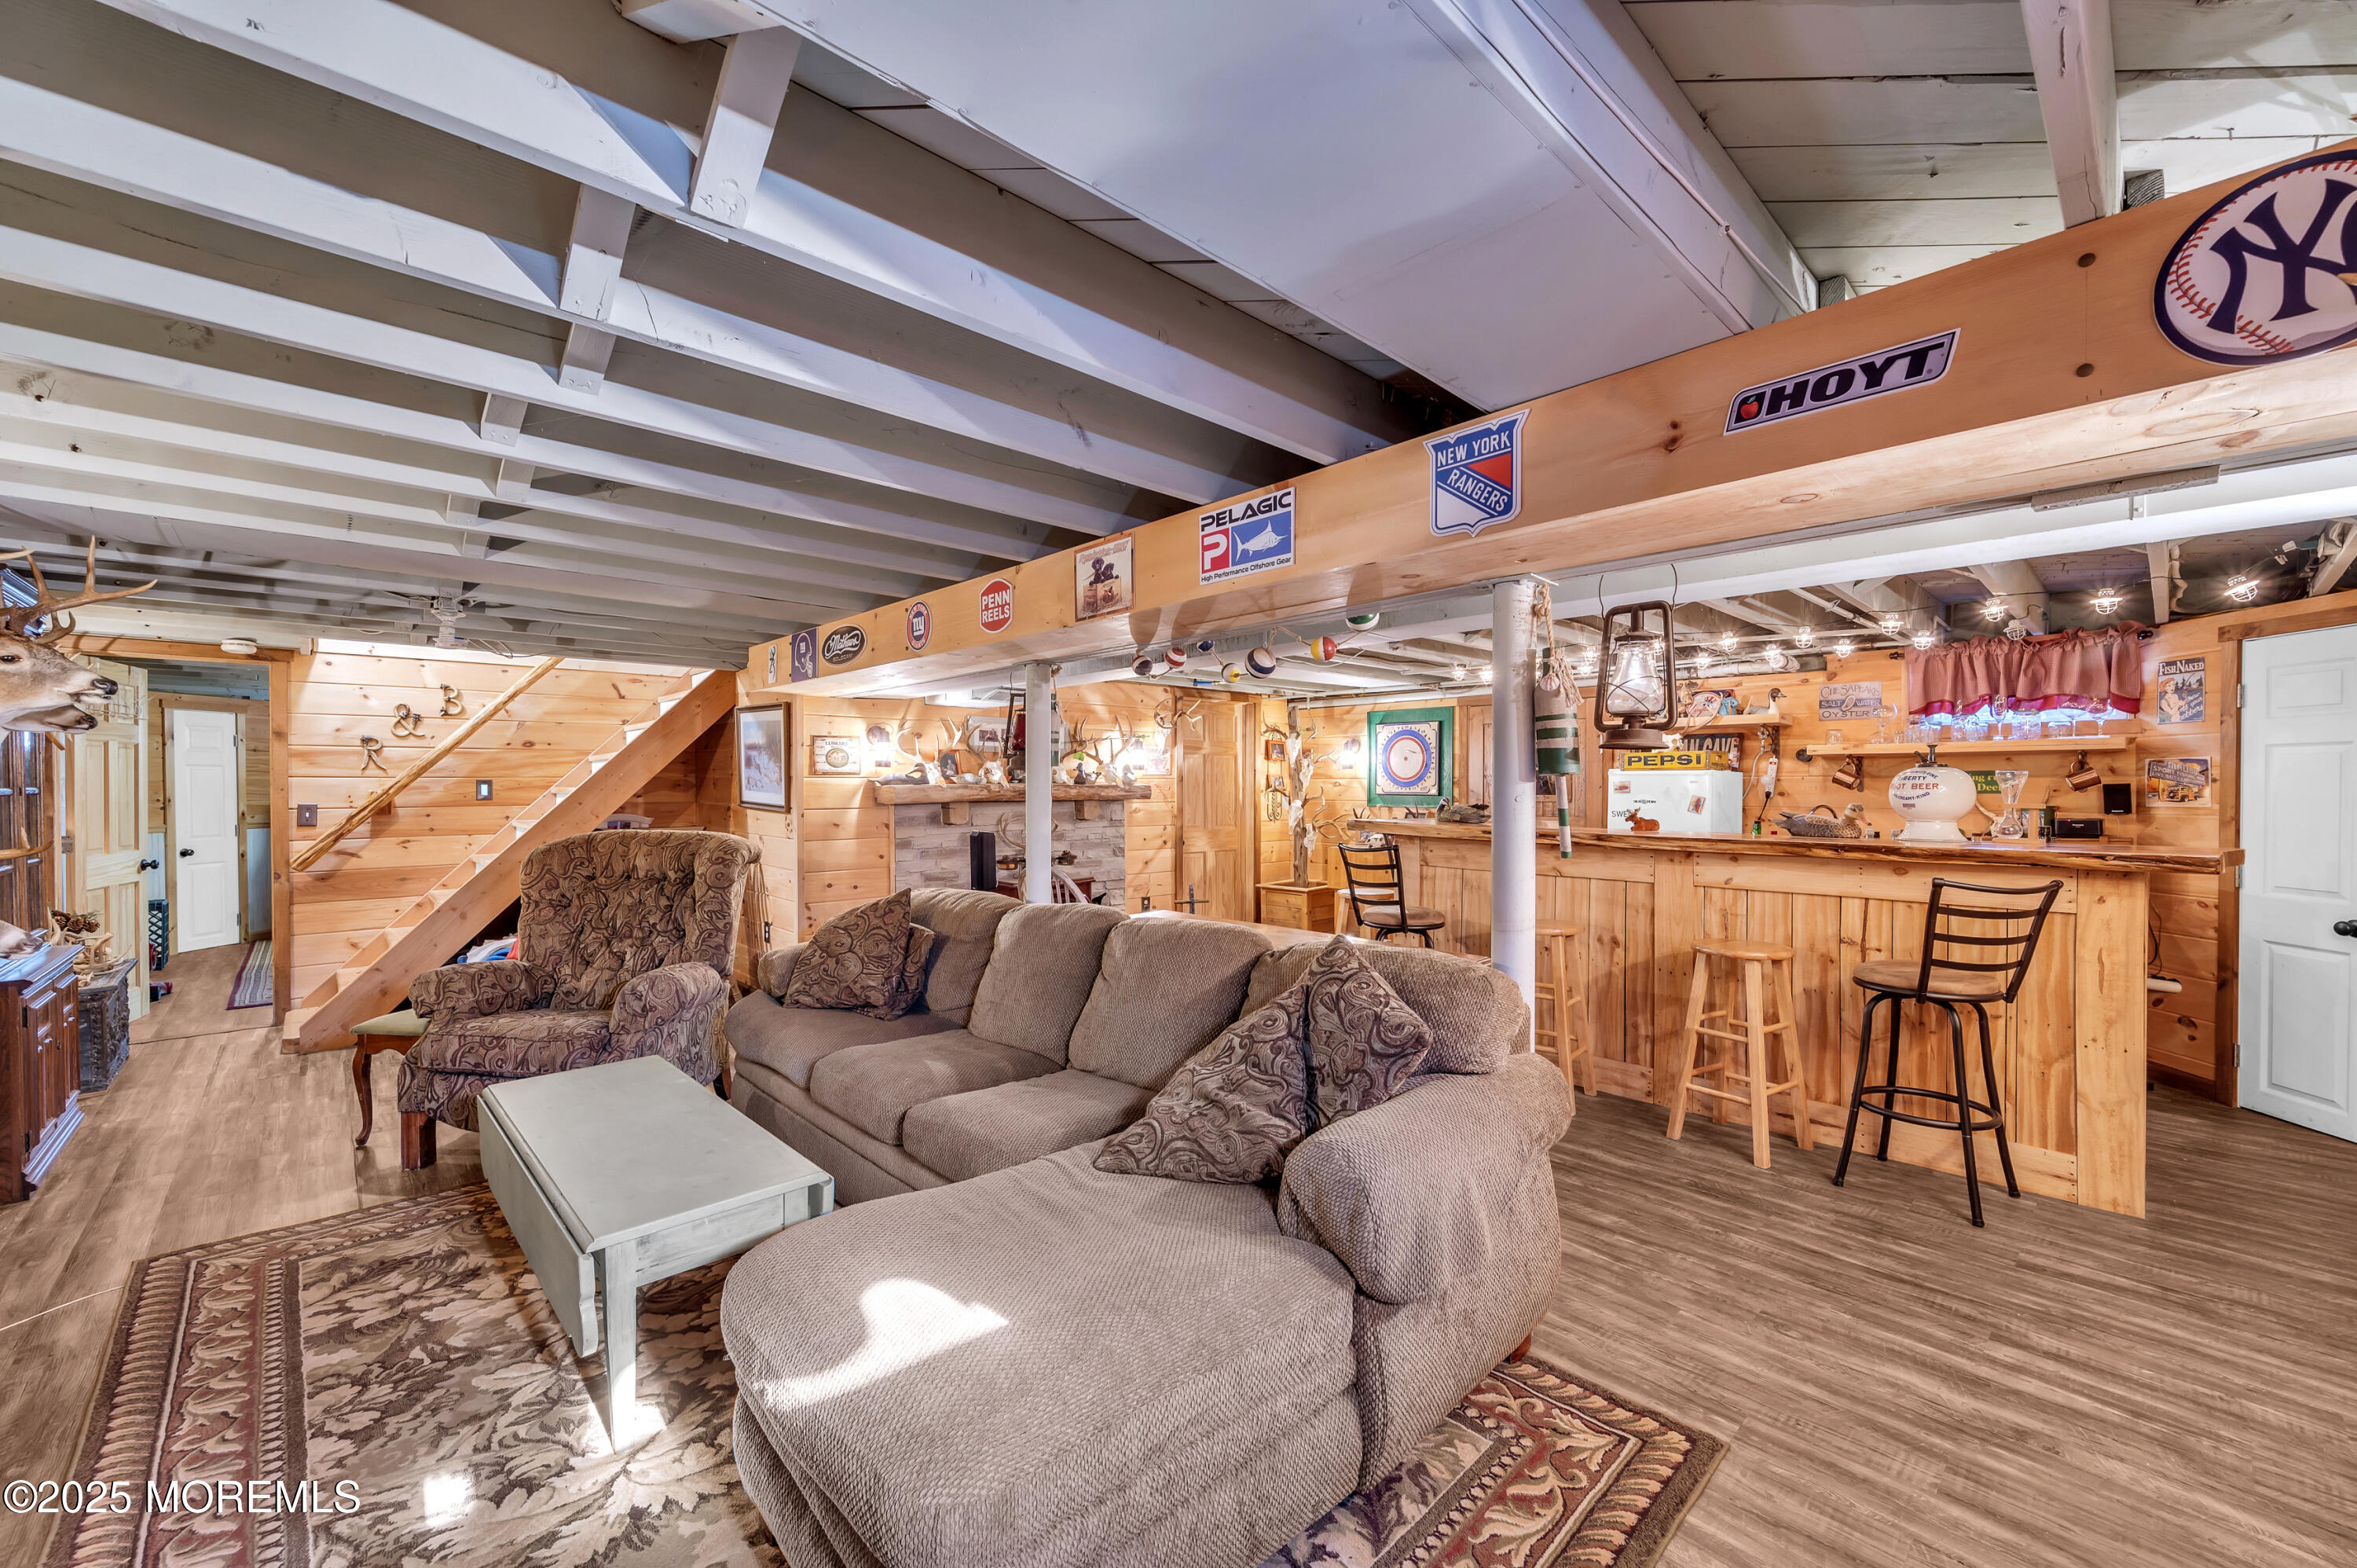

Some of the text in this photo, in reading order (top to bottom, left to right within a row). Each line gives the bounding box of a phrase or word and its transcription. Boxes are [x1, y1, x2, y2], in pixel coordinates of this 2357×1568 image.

[1765, 341, 1945, 417] HOYT
[1437, 430, 1511, 467] NEW YORK
[1446, 468, 1508, 511] RANGERS
[1200, 490, 1292, 532] PELAGIC
[1200, 557, 1292, 583] High Performance Offshore Gear
[982, 589, 1010, 610] PENN
[982, 605, 1010, 623] REELS
[2158, 660, 2205, 676] FISH NAKED
[1820, 684, 1880, 698] CHESAPEAKE
[1821, 698, 1880, 708] SALT WATER
[1821, 709, 1870, 719] OYSTER
[1627, 753, 1702, 767] PEPSI
